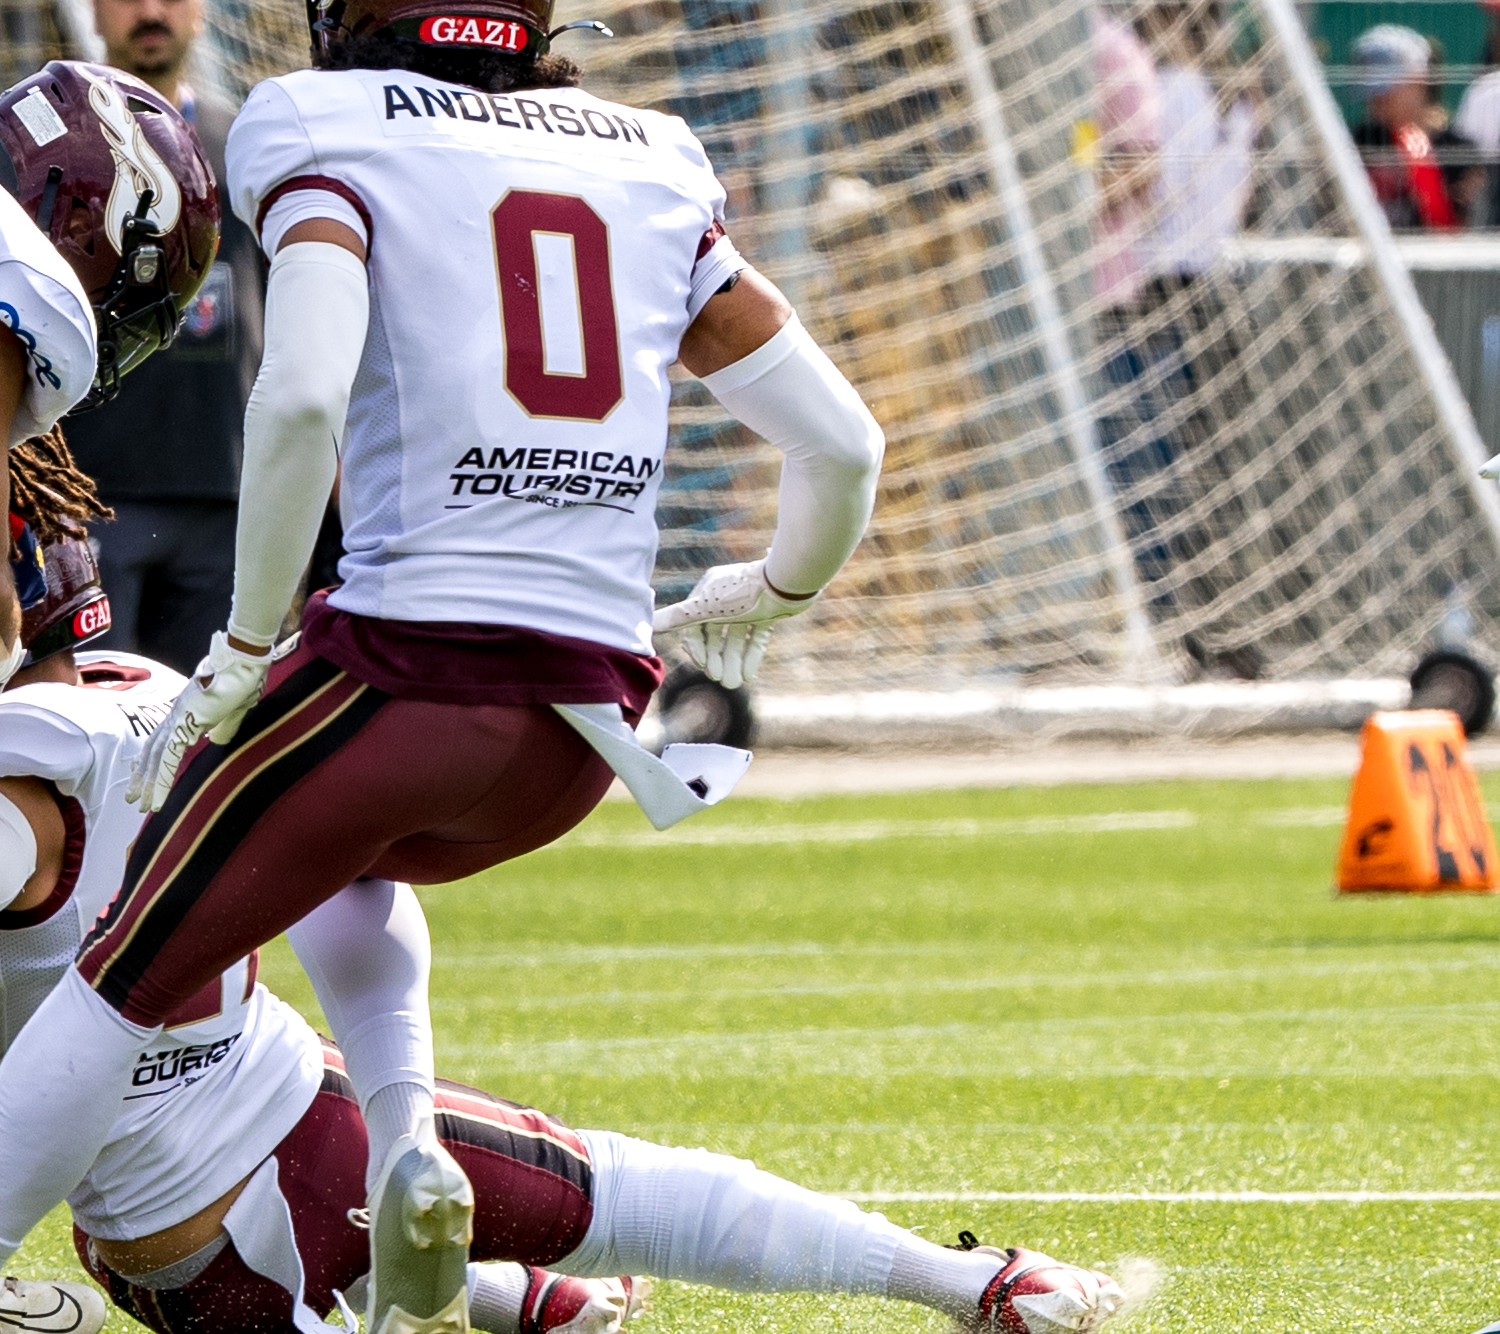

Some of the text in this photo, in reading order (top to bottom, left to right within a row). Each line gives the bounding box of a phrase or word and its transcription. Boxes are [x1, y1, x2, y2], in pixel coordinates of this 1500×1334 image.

[383, 83, 650, 148] ANDERSON
[489, 187, 624, 425] 0
[454, 445, 662, 479] AMERICAN
